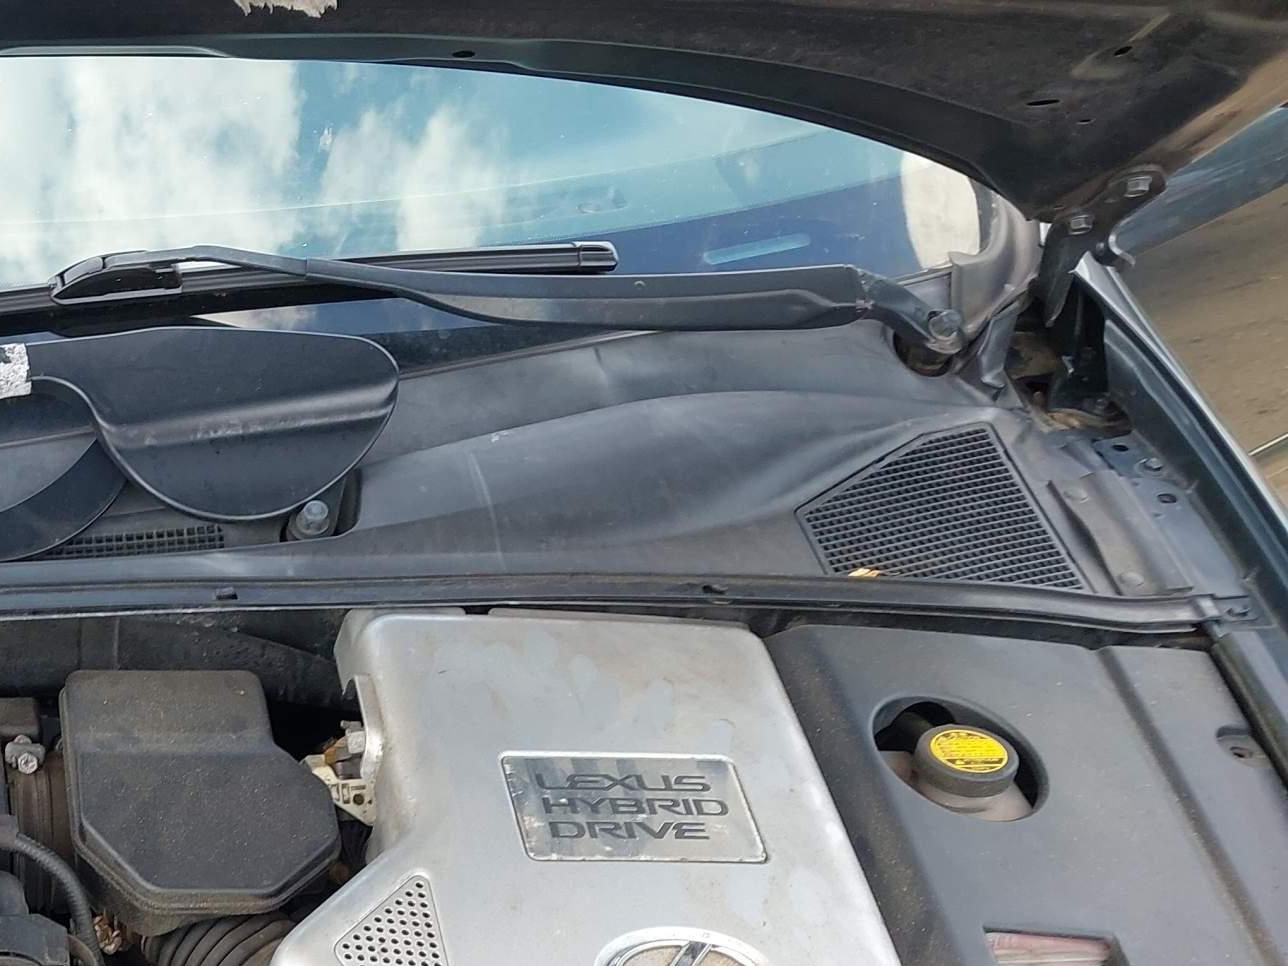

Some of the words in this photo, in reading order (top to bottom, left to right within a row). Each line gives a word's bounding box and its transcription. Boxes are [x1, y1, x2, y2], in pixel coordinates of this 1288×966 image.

[535, 773, 712, 793] LEXUS
[542, 797, 730, 816] HYBRID
[548, 821, 711, 840] DRIVE
